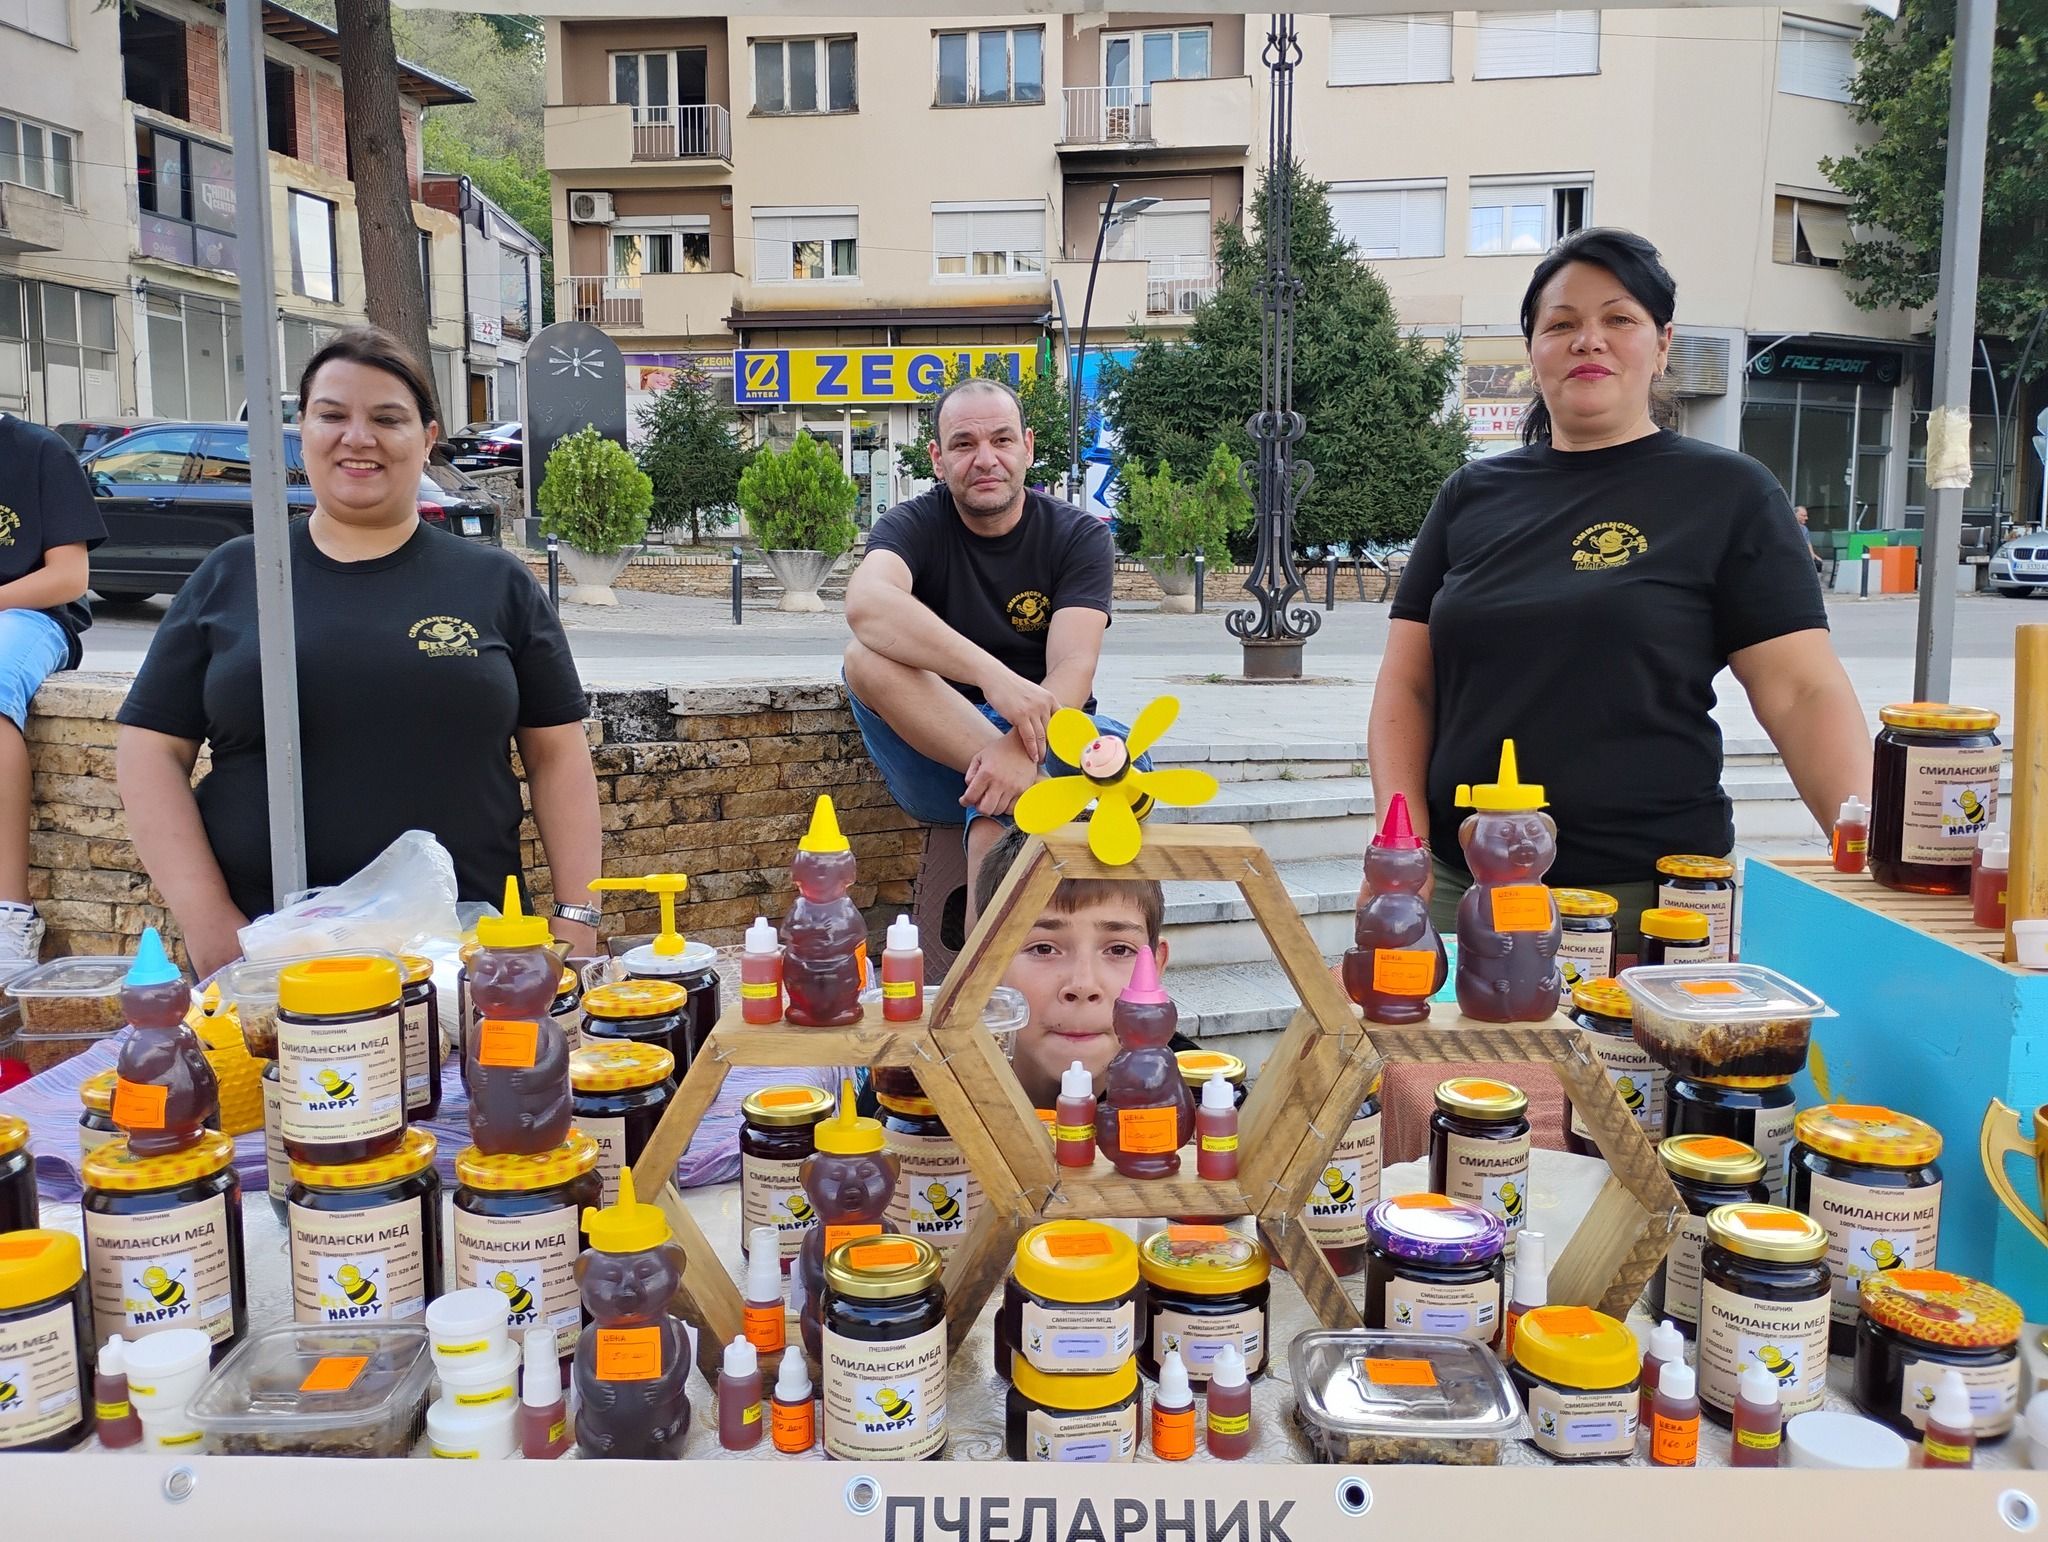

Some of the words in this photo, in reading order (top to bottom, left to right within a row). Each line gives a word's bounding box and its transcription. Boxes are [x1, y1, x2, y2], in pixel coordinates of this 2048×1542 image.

[482, 322, 492, 335] 22
[1781, 355, 1822, 369] FREE
[1822, 358, 1872, 373] SPORT
[1469, 407, 1520, 416] CIVIE
[1493, 422, 1515, 430] RE
[1572, 522, 1639, 546] СМИЛАНСКИ
[1572, 550, 1603, 562] BEE
[408, 615, 462, 638] СМИЛАНСКИ
[1012, 616, 1030, 625] BEE
[419, 640, 449, 650] BEE
[1919, 766, 1987, 776] СМИЛАНСКИ
[1949, 823, 1987, 835] HAPPY
[1664, 899, 1710, 910] СМИЛАНСКИ
[282, 1041, 356, 1054] СМИЛАНСКИ
[361, 1036, 389, 1050] МЕД
[1598, 1051, 1647, 1064] ИЛАНСКИ
[309, 1098, 359, 1112] HAPPY
[1357, 1135, 1375, 1149] МЕД
[1459, 1155, 1525, 1168] СМИЛАНСКИ
[750, 1172, 801, 1184] СМИЛАНС
[911, 1209, 936, 1222] BEE
[1313, 1202, 1357, 1216] HAPPY
[1823, 1200, 1910, 1222] СМИЛАНСКИ
[1913, 1207, 1934, 1221] МЕД
[778, 1218, 818, 1231] HAPPY
[917, 1220, 964, 1233] HAPPY
[1839, 1221, 1856, 1229] 100%
[95, 1232, 181, 1250] СМИЛАНСКИ
[185, 1222, 216, 1241] МЕД
[297, 1229, 374, 1246] СМИЛАНСКИ
[378, 1224, 410, 1241] МЕД
[459, 1233, 530, 1252] СМИЛАНСКИ
[535, 1234, 566, 1250] МЕД
[134, 1303, 191, 1325] HAPPY
[328, 1303, 382, 1321] HAPPY
[1754, 1303, 1793, 1312] ПЧЕЛАРНИК
[508, 1312, 538, 1325] PPY
[1711, 1305, 1800, 1332] СМИЛАНСКИ
[1804, 1315, 1826, 1329] МЕД
[1725, 1322, 1741, 1332] 100%
[23, 1330, 59, 1349] МЕД
[603, 1334, 626, 1342] ЦЕНА
[830, 1354, 915, 1372] СМИЛАНСКИ
[918, 1345, 942, 1364] МЕД
[842, 1370, 858, 1379] 100%
[865, 1417, 917, 1432] HAPPY
[1660, 1420, 1683, 1432] ЦЕНА
[884, 1495, 1297, 1542] ПЧЕЛАРНИК
